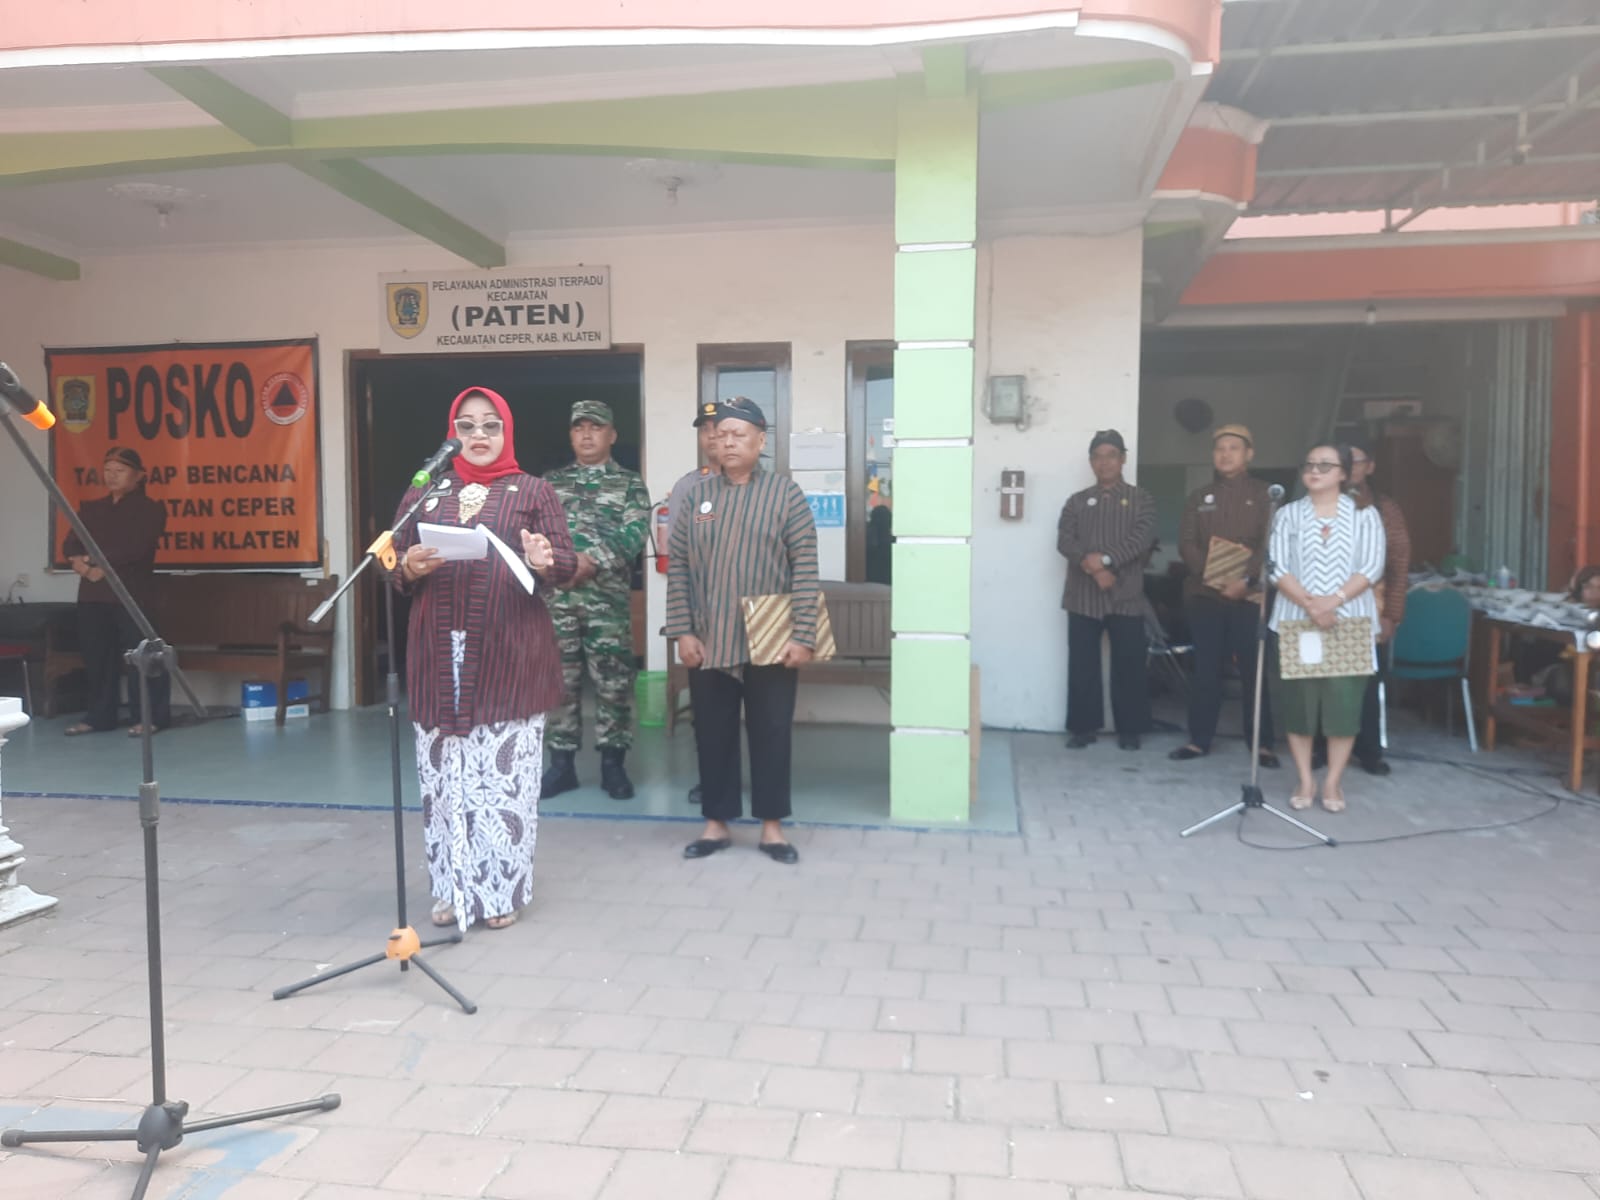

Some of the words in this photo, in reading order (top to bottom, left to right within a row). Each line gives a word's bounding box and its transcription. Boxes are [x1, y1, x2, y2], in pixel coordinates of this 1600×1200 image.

[432, 280, 487, 291] PELAYANAN
[489, 277, 556, 289] ADMINISTRASI
[559, 276, 603, 287] TERPADU
[487, 291, 548, 301] KECAMATAN
[437, 334, 496, 345] KECAMATAN
[499, 333, 534, 344] CEPER,
[536, 332, 559, 343] KAB.
[563, 331, 601, 342] KLATEN
[106, 361, 255, 440] POSKO
[187, 463, 297, 484] BENCANA
[221, 497, 296, 517] CEPER
[212, 530, 300, 550] KLATEN
